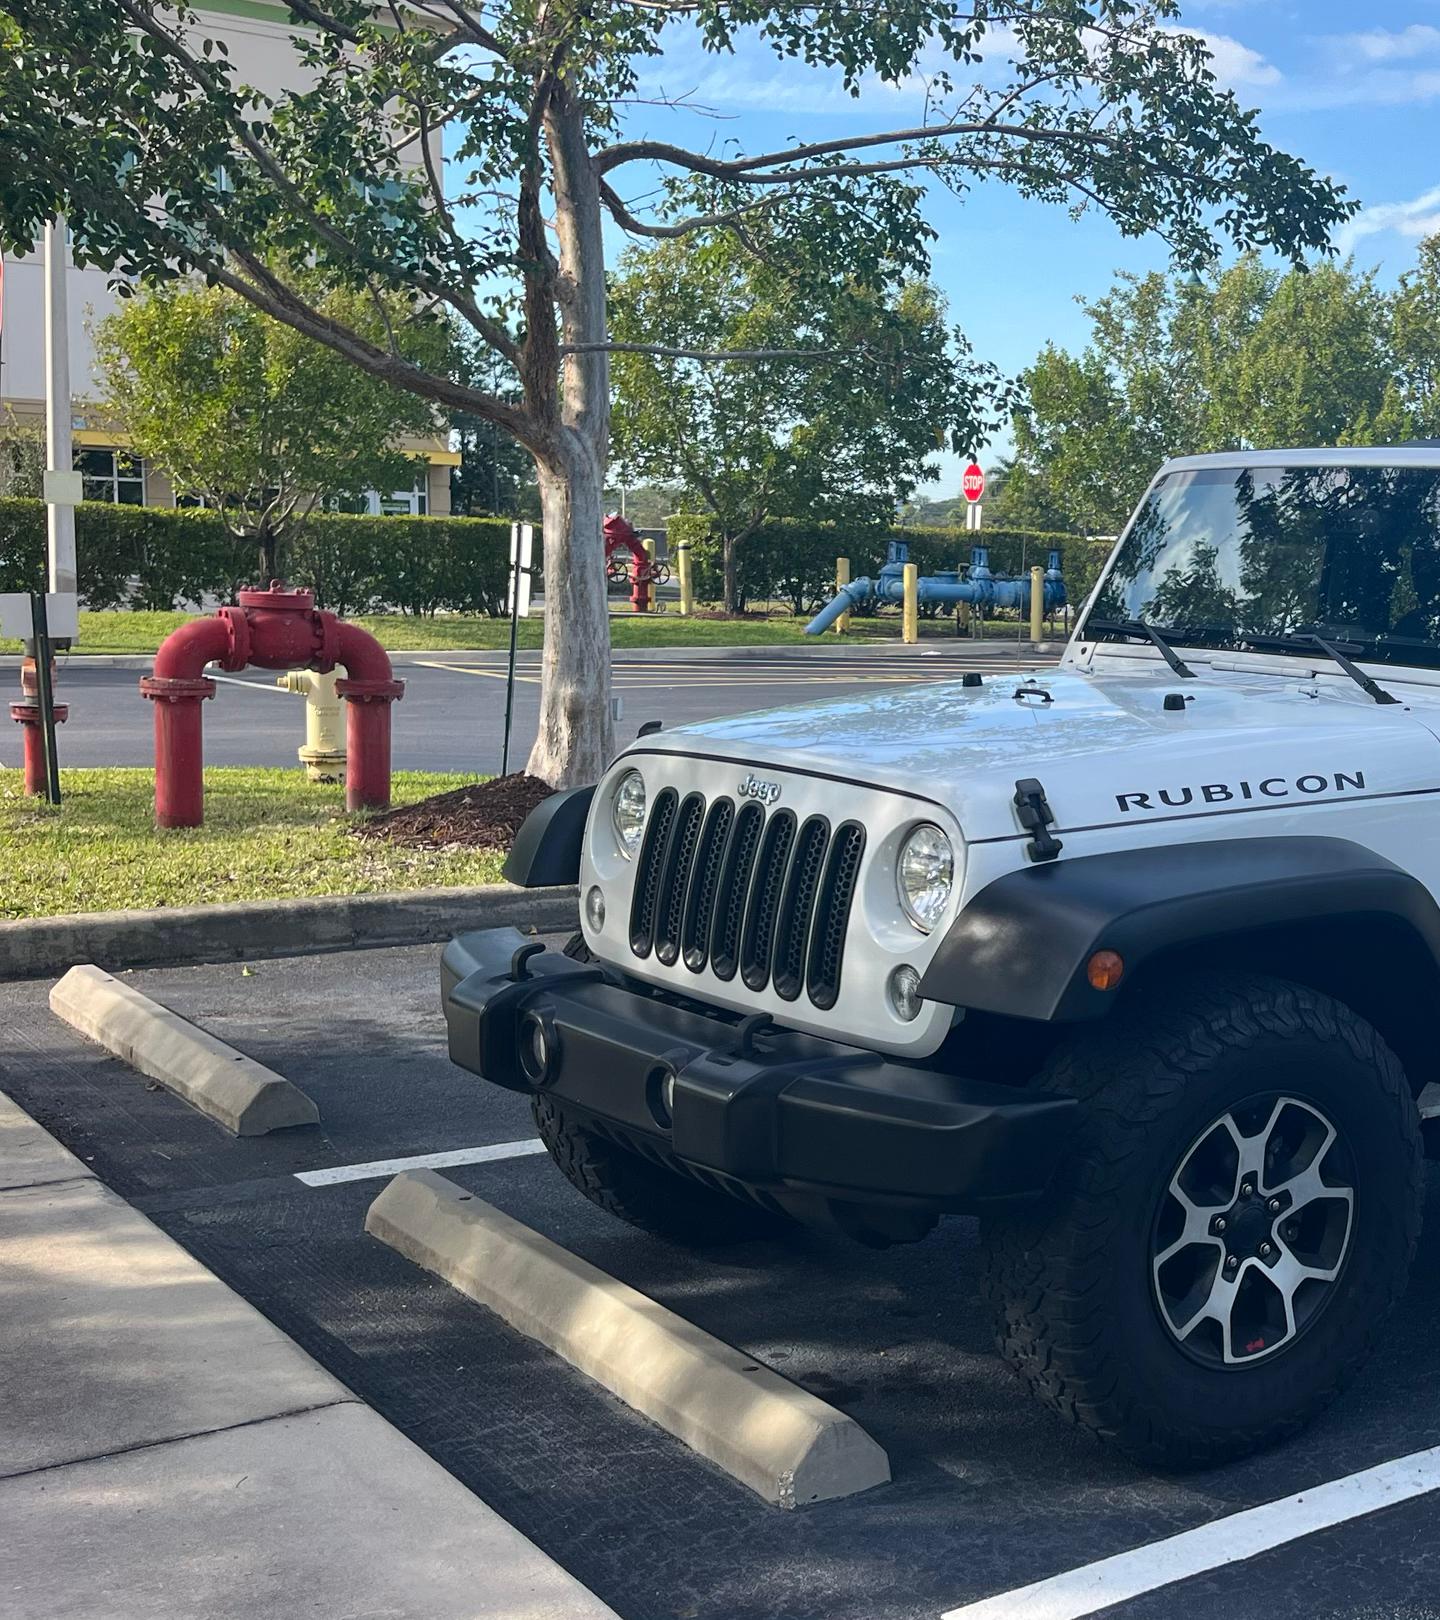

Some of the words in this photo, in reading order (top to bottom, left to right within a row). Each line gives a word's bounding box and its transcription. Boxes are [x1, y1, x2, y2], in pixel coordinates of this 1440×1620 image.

[964, 475, 983, 490] STOP
[737, 773, 782, 806] Jeep
[1115, 771, 1366, 812] RUBICON
